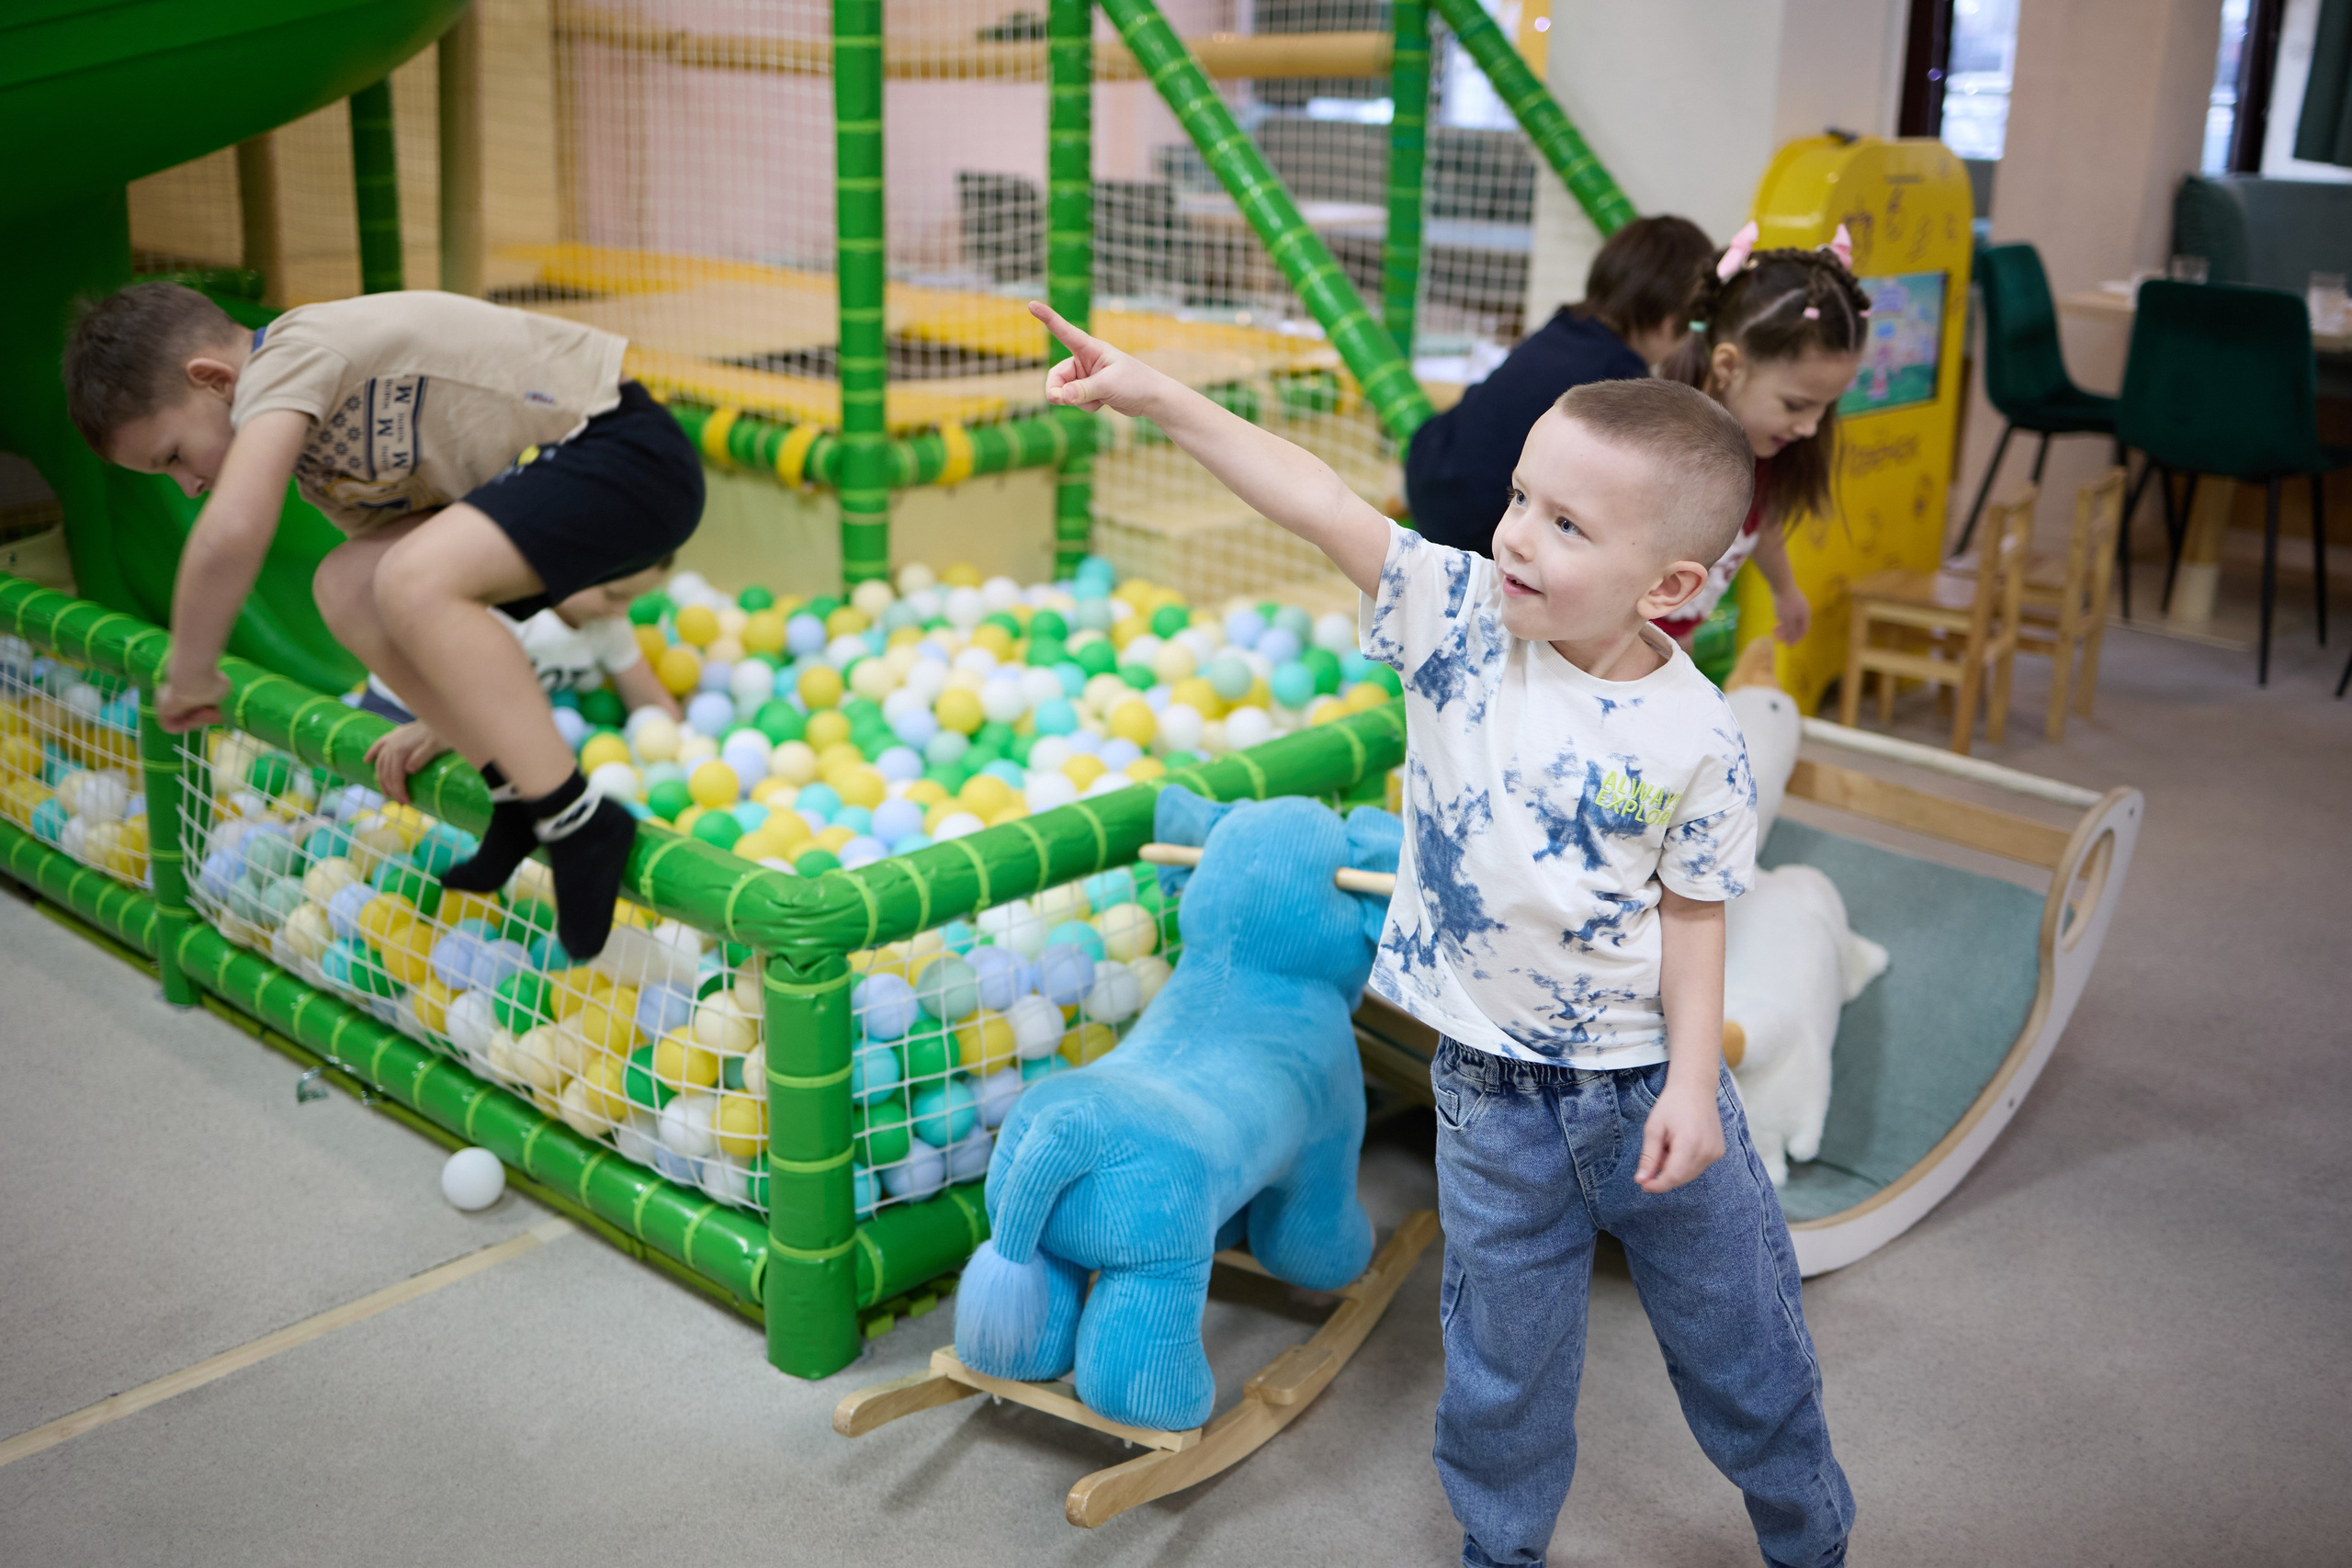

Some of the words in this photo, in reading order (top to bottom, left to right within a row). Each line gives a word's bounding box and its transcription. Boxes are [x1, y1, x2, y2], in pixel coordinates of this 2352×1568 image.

[394, 385, 413, 404] M
[377, 418, 393, 436] M
[392, 451, 409, 468] M
